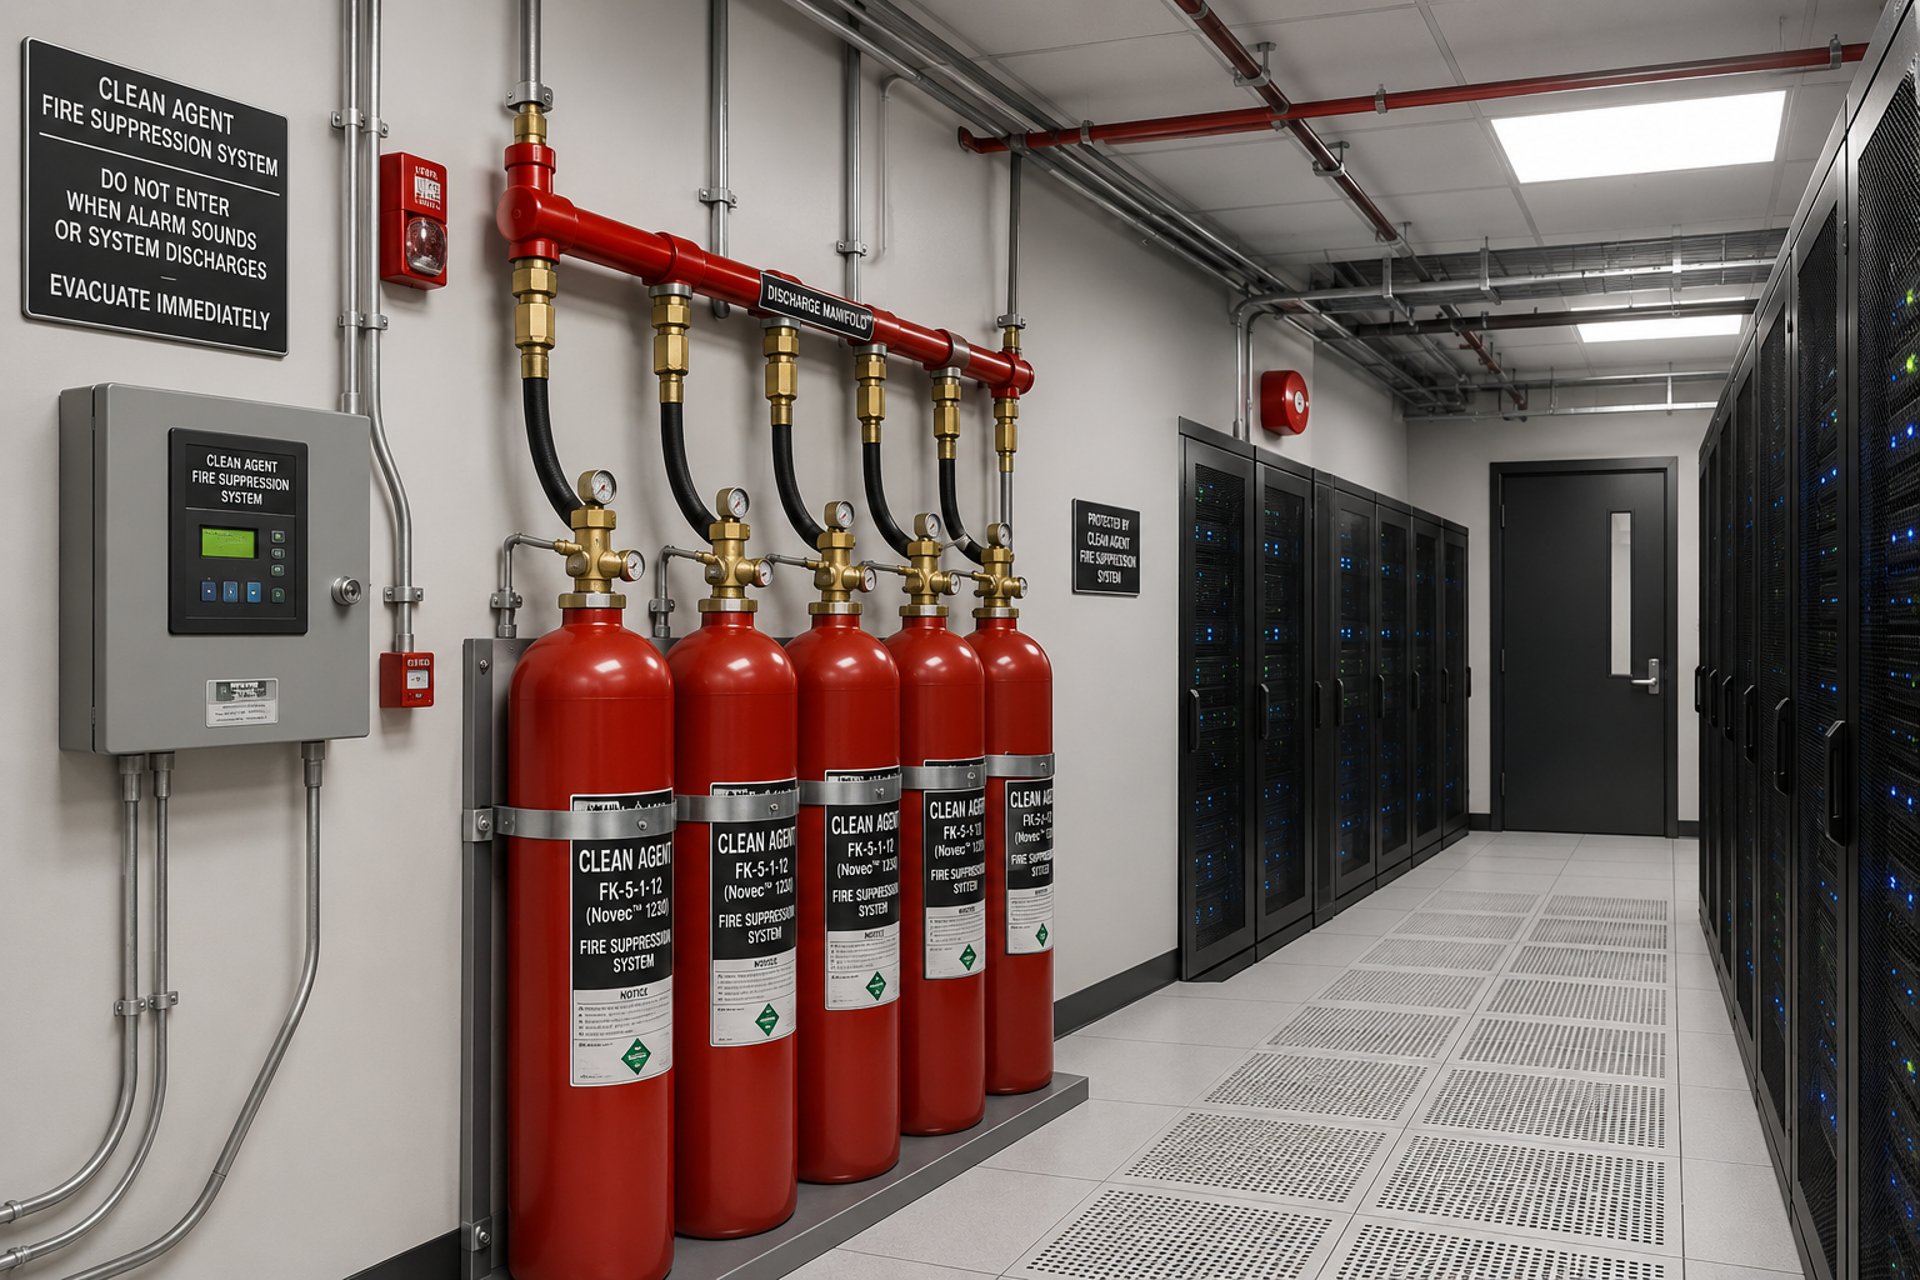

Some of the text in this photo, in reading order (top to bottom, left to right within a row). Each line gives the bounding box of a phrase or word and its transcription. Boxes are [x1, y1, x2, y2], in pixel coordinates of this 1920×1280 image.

[99, 76, 234, 135] CLEAN AGENT
[43, 94, 279, 177] FIRE SUPPRESSION SYSTEM
[101, 168, 230, 217] DO NOT ENTER
[66, 190, 257, 251] WHEN ALARM SOUNDS
[55, 219, 267, 280] OR SYSTEM DISCHARGES
[50, 273, 271, 331] EVACUATE IMMEDIATELY
[768, 285, 867, 330] DISCHARGE MANIFOLD
[206, 454, 278, 473] CLEAN AGENT
[192, 470, 289, 491] FIRE SUPPRESSION
[221, 490, 262, 505] SYSTEM
[1010, 790, 1041, 808] CLEAN
[930, 800, 966, 820] CLEAN
[831, 814, 873, 835] CLEAN
[718, 826, 796, 855] CLEAN AGENT
[848, 838, 894, 858] FK-5-1-12
[579, 841, 672, 873] CLEAN AGENT
[735, 857, 788, 879] FK-5-1-12
[931, 868, 949, 881] FIRE
[600, 876, 662, 901] FK-5-1-12
[832, 889, 854, 903] FIRE
[858, 901, 888, 917] SYSTEM
[719, 913, 742, 928] FIRE
[580, 928, 671, 955] FIRE SUPPRESSION
[748, 926, 782, 944] SYSTEM
[613, 953, 654, 973] SYSTEM
